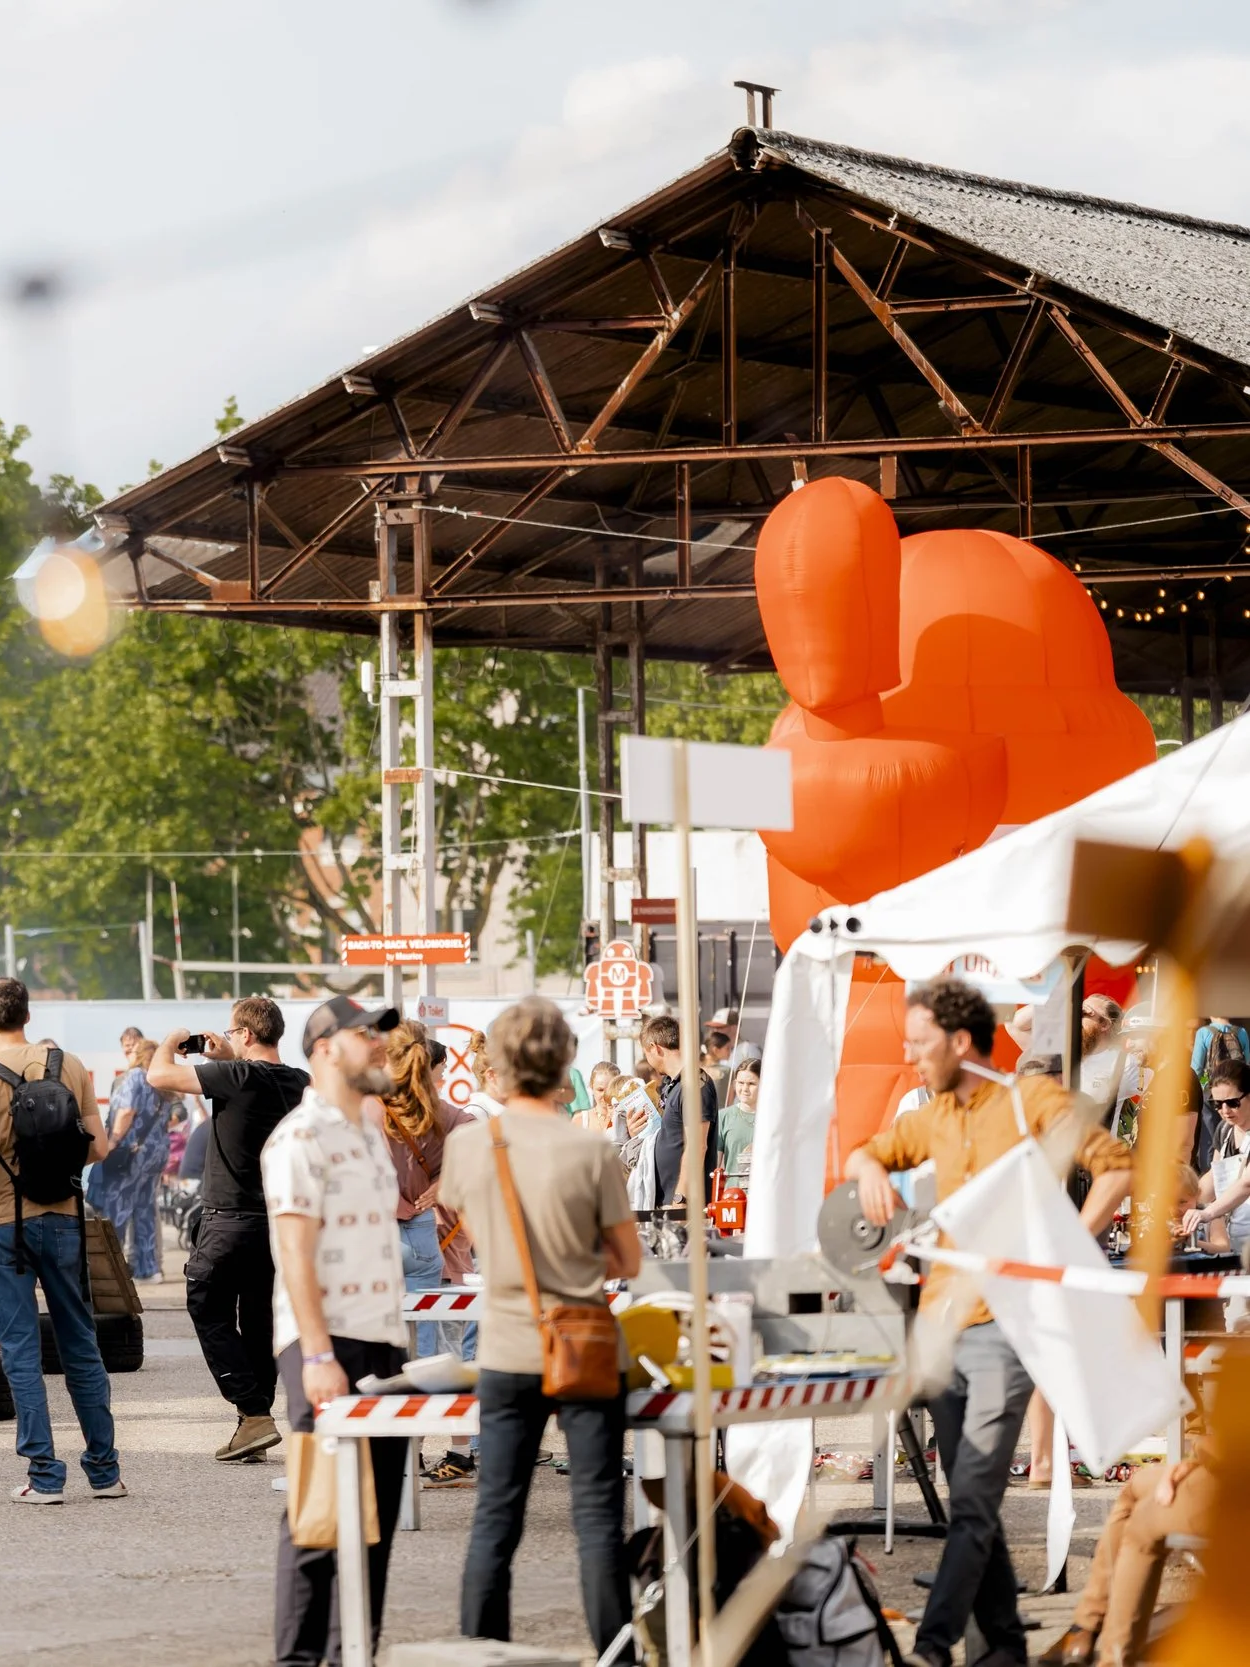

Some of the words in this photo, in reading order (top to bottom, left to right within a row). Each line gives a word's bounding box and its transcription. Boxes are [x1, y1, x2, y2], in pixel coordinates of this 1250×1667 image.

[347, 939, 407, 950] BACK-TO-BACK
[409, 938, 464, 949] VELOMOBIEL
[611, 968, 626, 981] M
[722, 1207, 737, 1222] M
